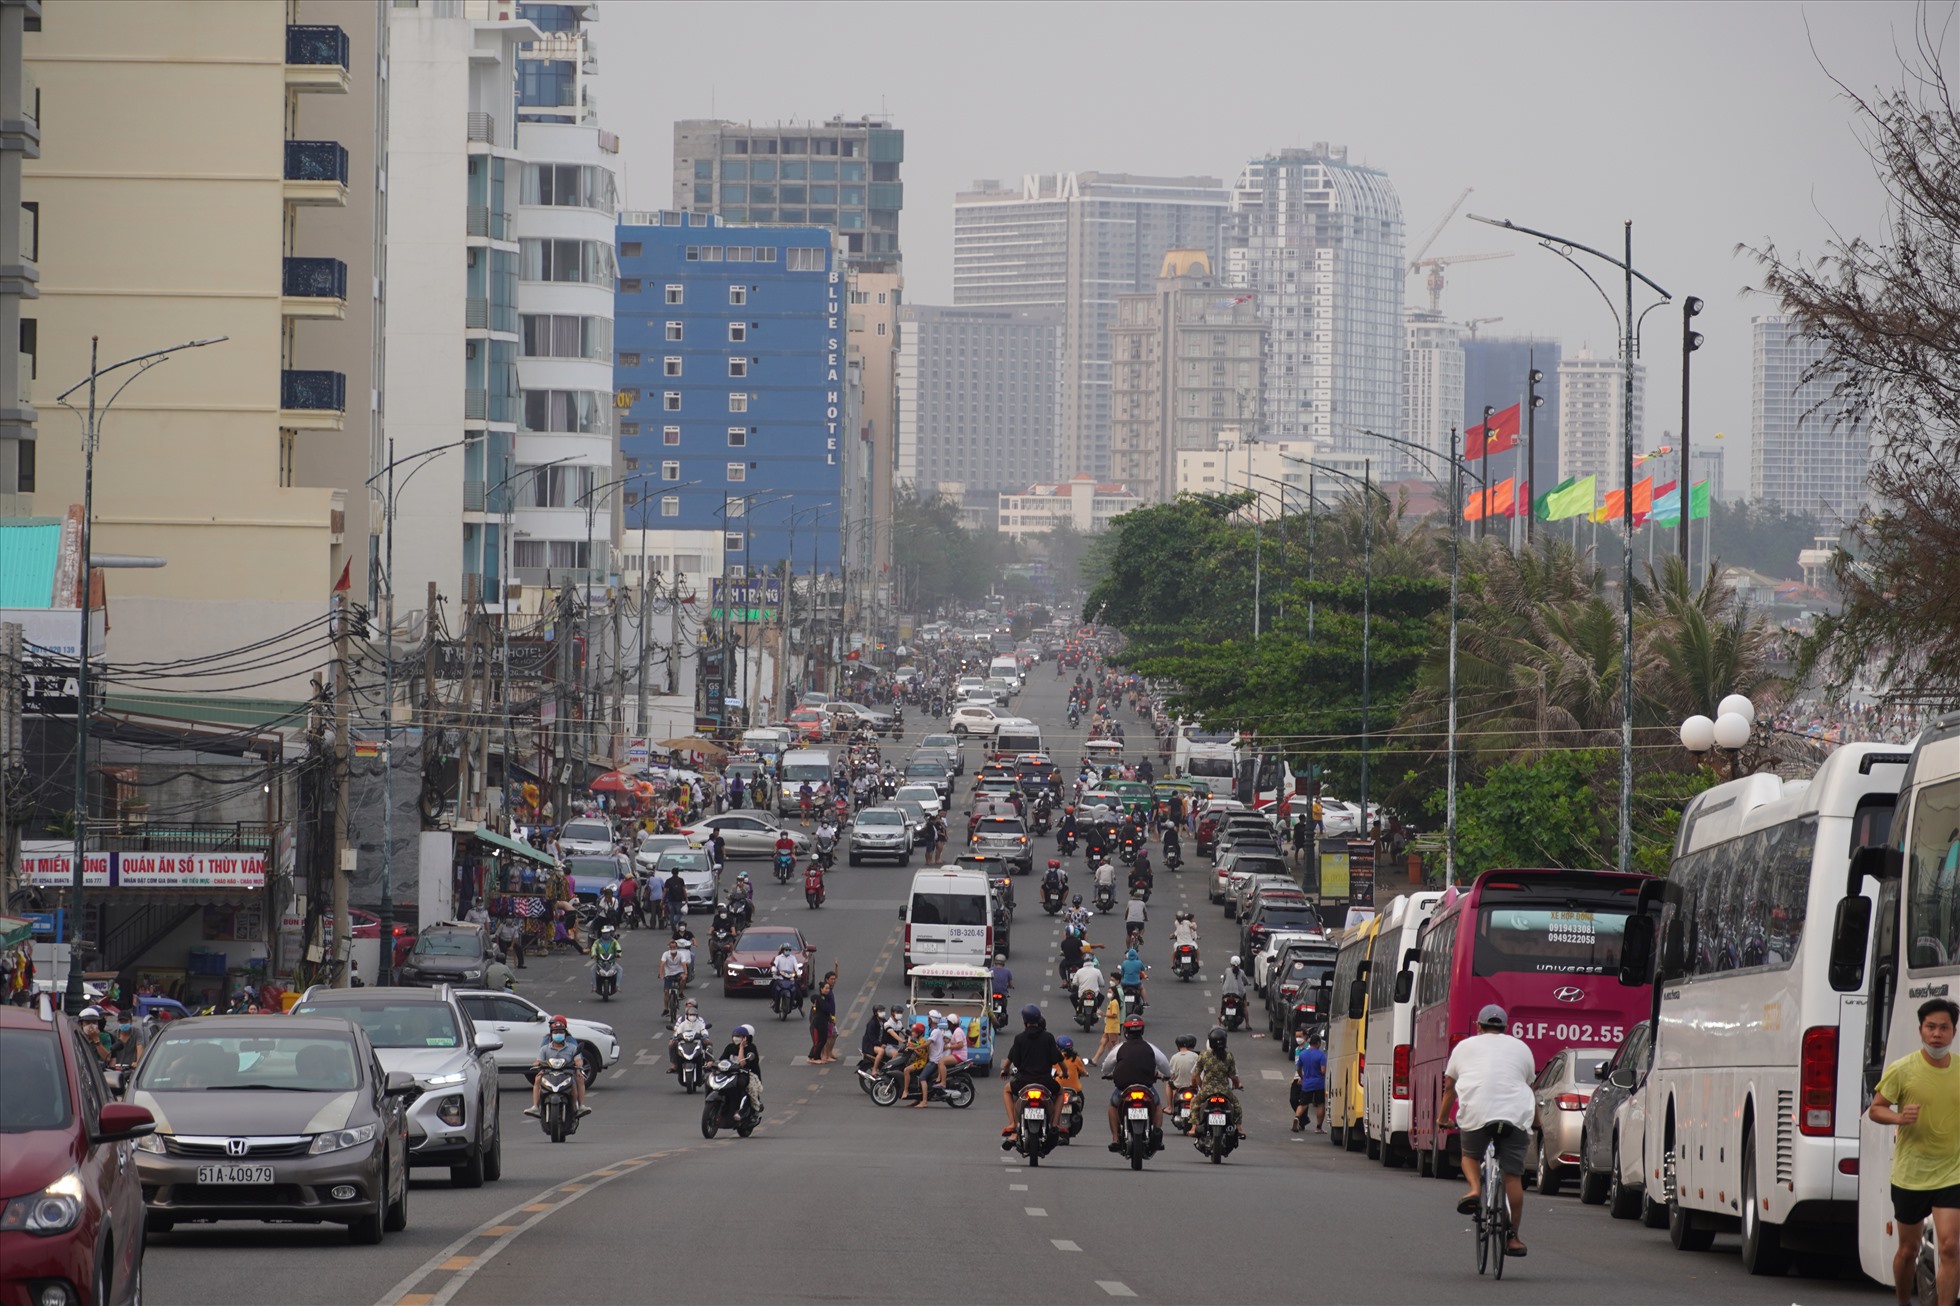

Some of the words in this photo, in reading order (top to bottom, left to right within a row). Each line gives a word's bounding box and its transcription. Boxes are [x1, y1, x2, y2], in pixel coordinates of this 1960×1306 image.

[828, 271, 838, 329] BLUE
[828, 338, 838, 381] SEA
[827, 391, 838, 465] HOTEL
[508, 647, 543, 657] HOTEL
[708, 682, 720, 690] GS
[83, 855, 107, 873] ÔNG
[122, 856, 155, 874] QUÁN
[158, 856, 175, 873] ĂN
[178, 854, 195, 874] SỐ
[198, 859, 204, 873] 1
[209, 856, 237, 874] THÙY
[1551, 912, 1559, 920] XE
[950, 928, 984, 937] 51B-320.45
[1549, 923, 1595, 934] 0919433081
[1548, 933, 1595, 944] 0949222058
[1536, 964, 1603, 974] UNIVERSE
[1512, 1021, 1624, 1043] 61F-002.55
[199, 1167, 272, 1182] 51A-409.79
